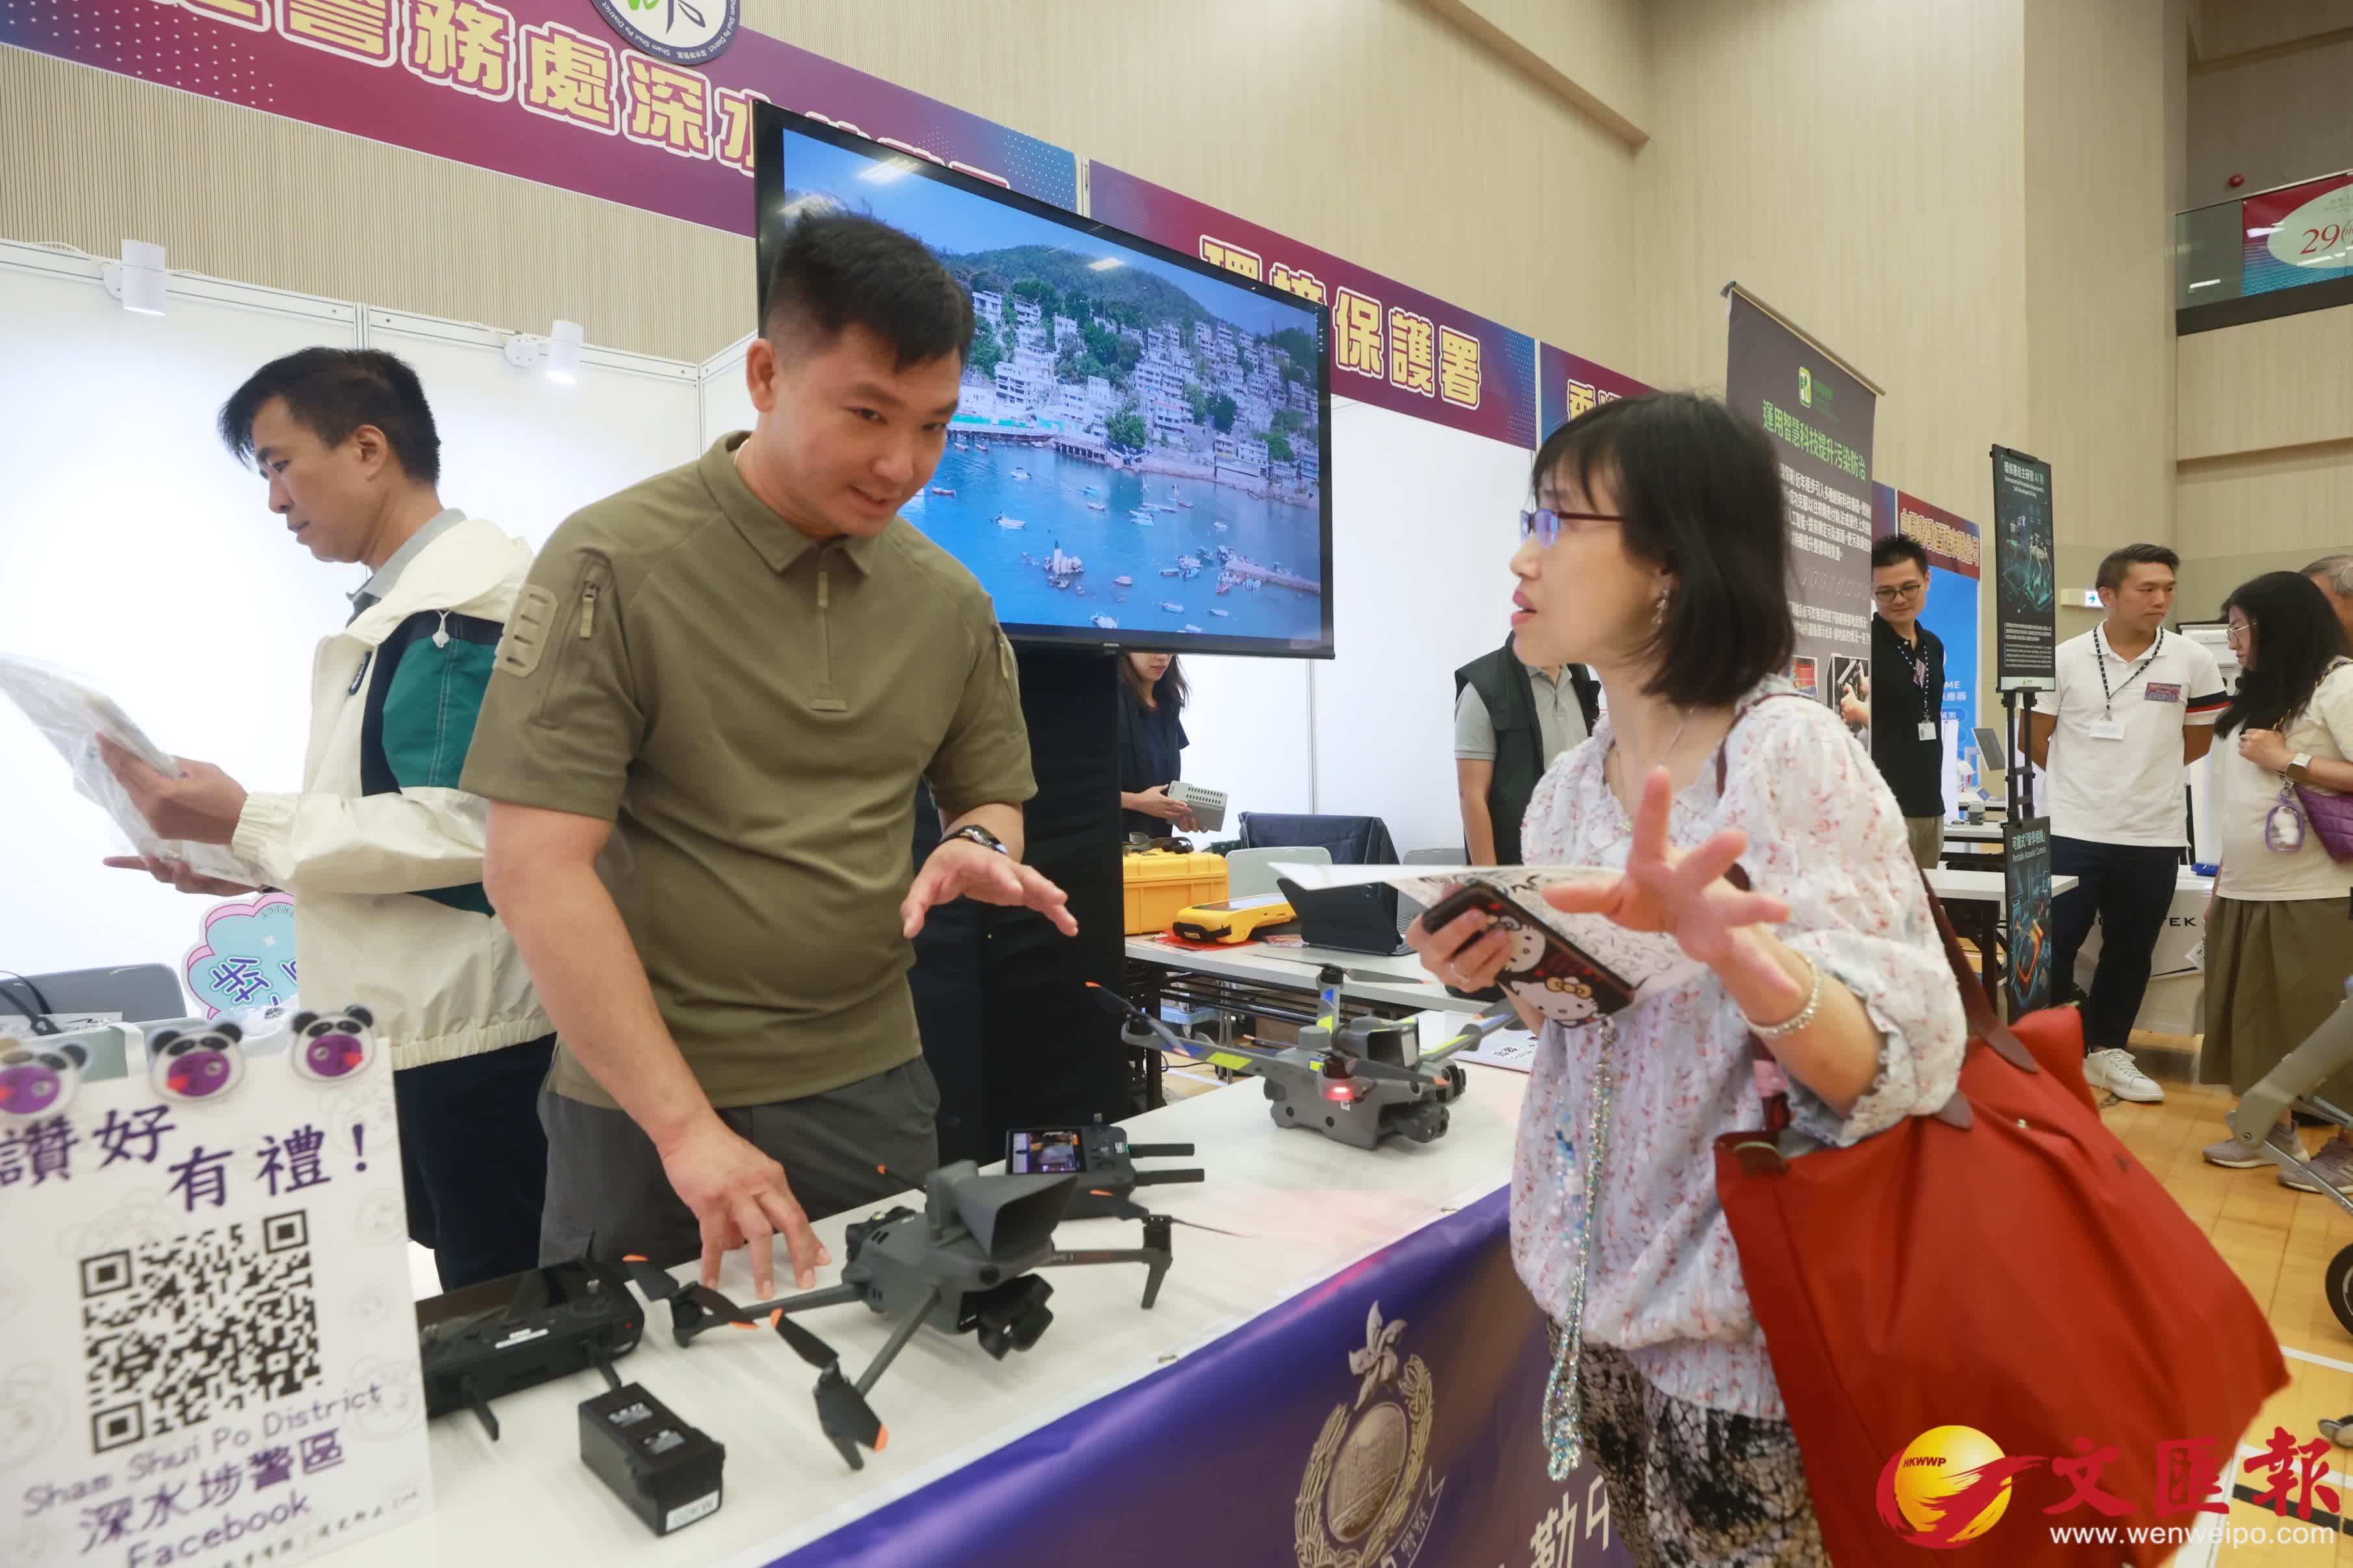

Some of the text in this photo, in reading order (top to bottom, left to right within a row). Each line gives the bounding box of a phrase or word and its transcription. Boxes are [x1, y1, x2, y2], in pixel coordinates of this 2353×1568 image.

[2300, 223, 2339, 255] 29
[0, 1104, 176, 1187] 讚好
[22, 1383, 382, 1517] Sham Shui Po District
[126, 1491, 312, 1568] Facebook
